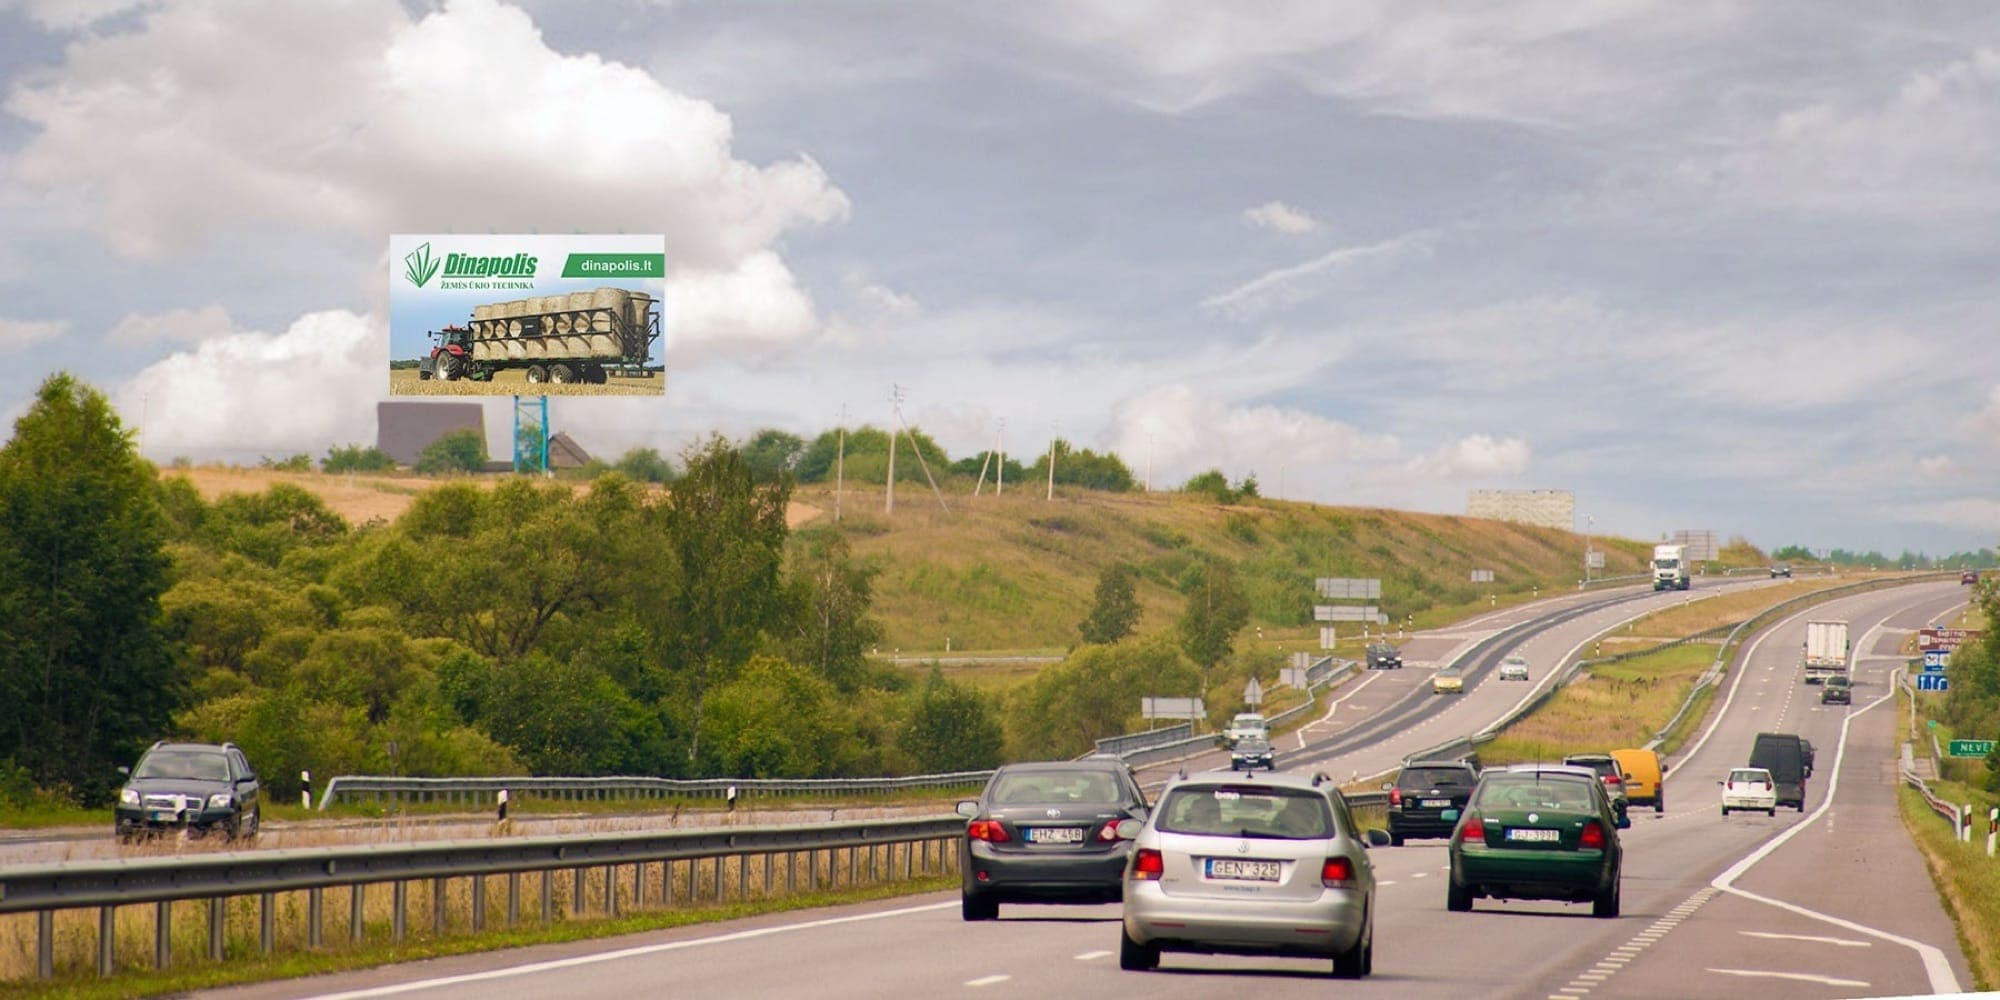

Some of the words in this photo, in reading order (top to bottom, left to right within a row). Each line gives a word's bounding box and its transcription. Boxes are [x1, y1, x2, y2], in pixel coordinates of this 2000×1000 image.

[443, 253, 538, 277] Dinapolis
[581, 260, 652, 273] dinapolis.lt
[1214, 862, 1243, 874] GEN
[1252, 863, 1277, 876] 325
